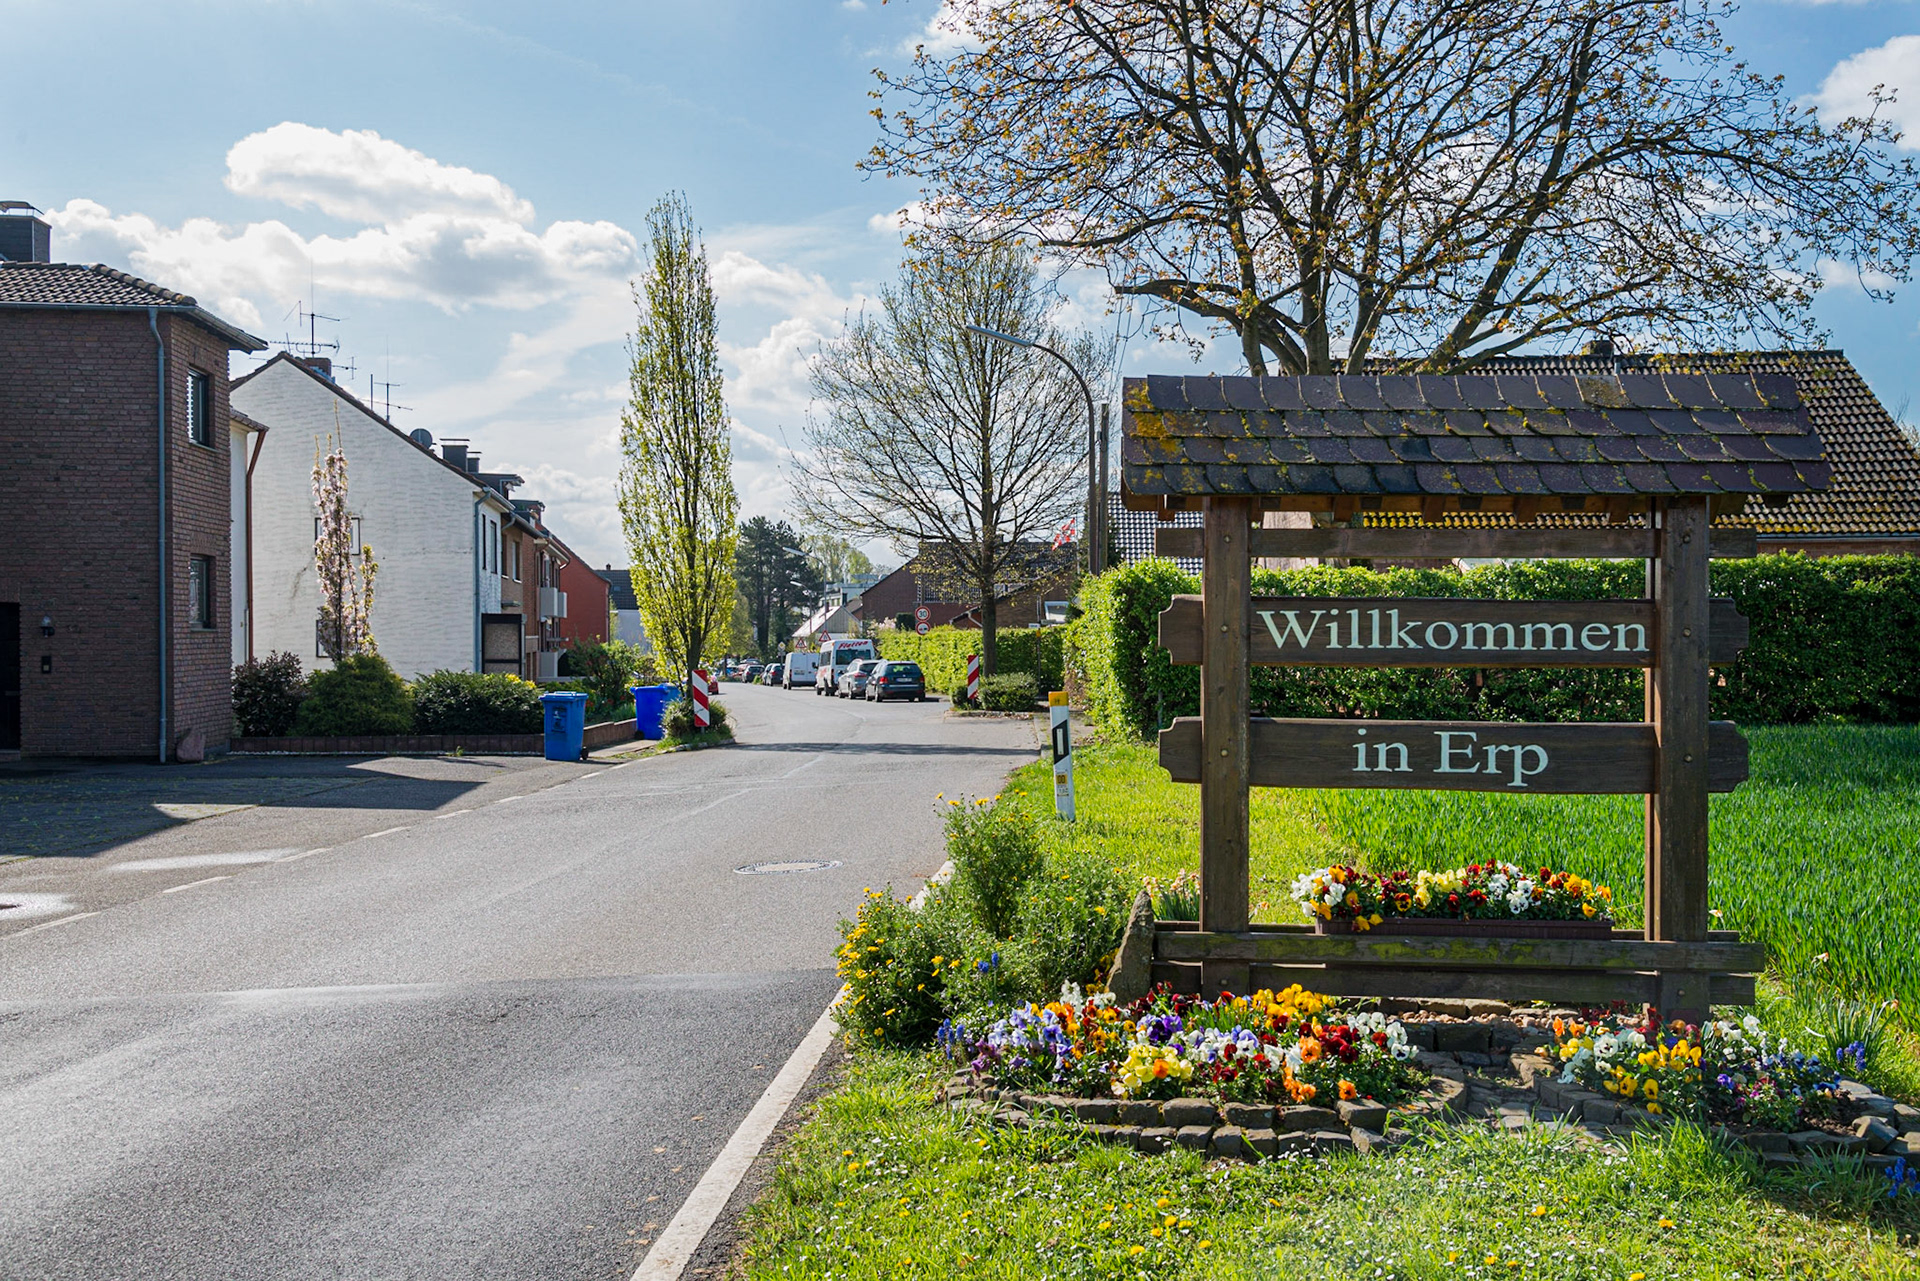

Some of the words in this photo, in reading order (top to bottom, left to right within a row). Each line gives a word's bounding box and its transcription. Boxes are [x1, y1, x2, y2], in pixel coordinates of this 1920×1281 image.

[1257, 608, 1649, 652] Willkommen
[1352, 728, 1413, 772] in
[1433, 731, 1549, 787] Erp
